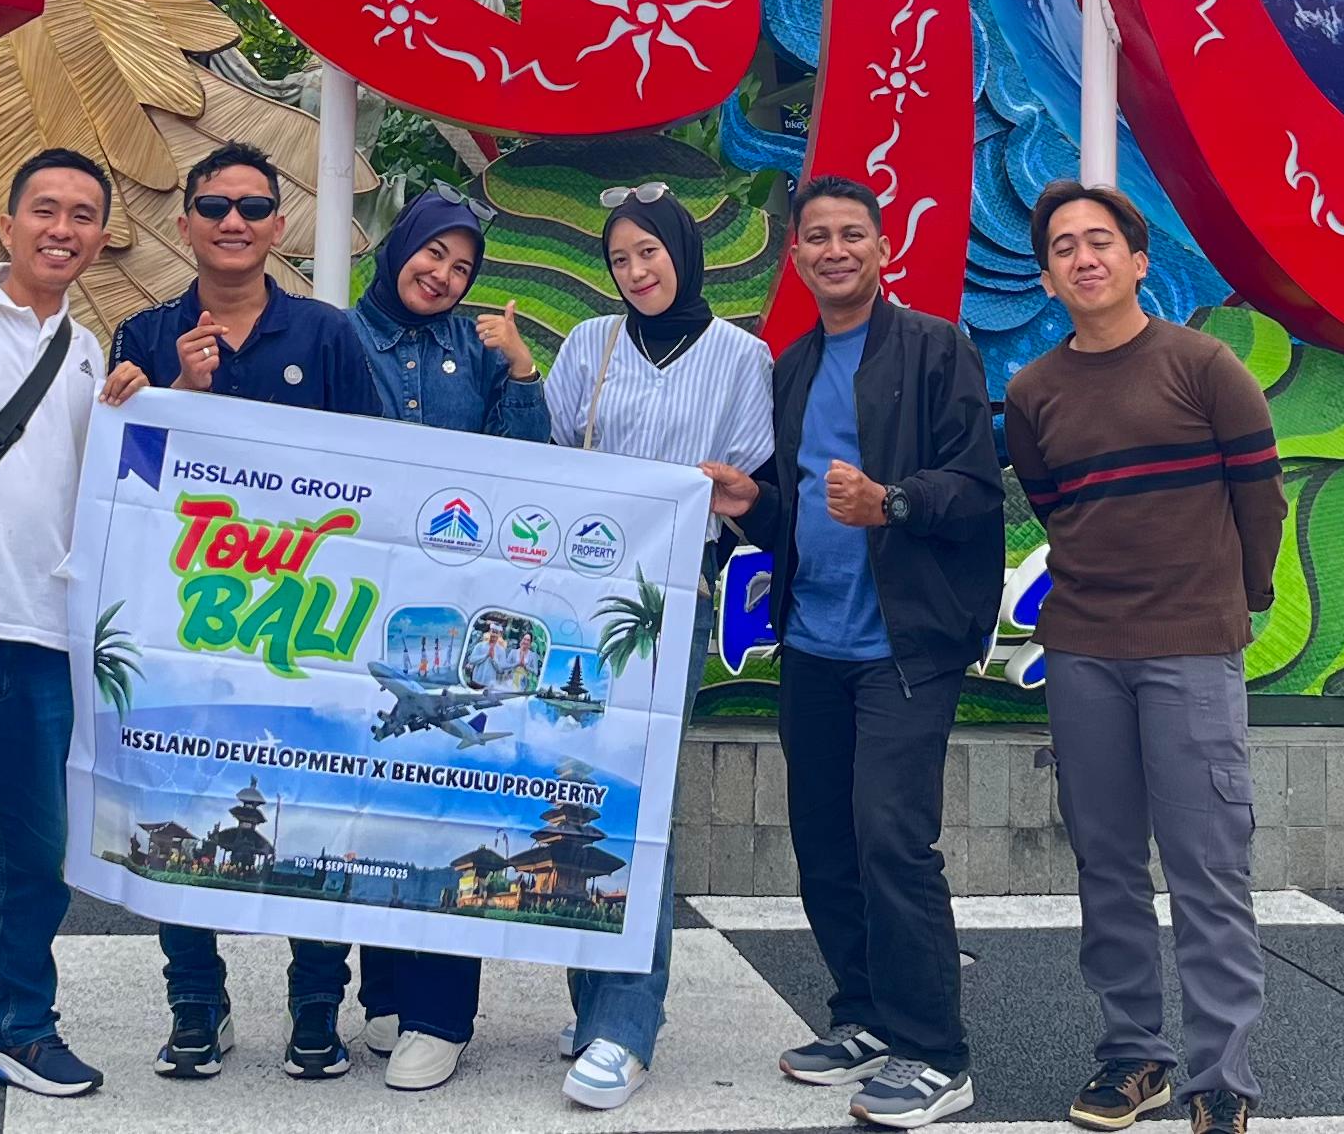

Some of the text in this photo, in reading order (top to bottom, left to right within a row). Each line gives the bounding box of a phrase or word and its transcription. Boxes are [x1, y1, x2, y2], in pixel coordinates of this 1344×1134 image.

[173, 460, 372, 503] HSSLAND GROUP
[571, 544, 616, 559] PROPERTY
[182, 573, 374, 673] BALI
[121, 727, 607, 805] HSSLAND DEVELOPMENT X BENGKULU PROPERTY
[324, 860, 381, 877] SEPTEMBER
[383, 867, 409, 880] 2025
